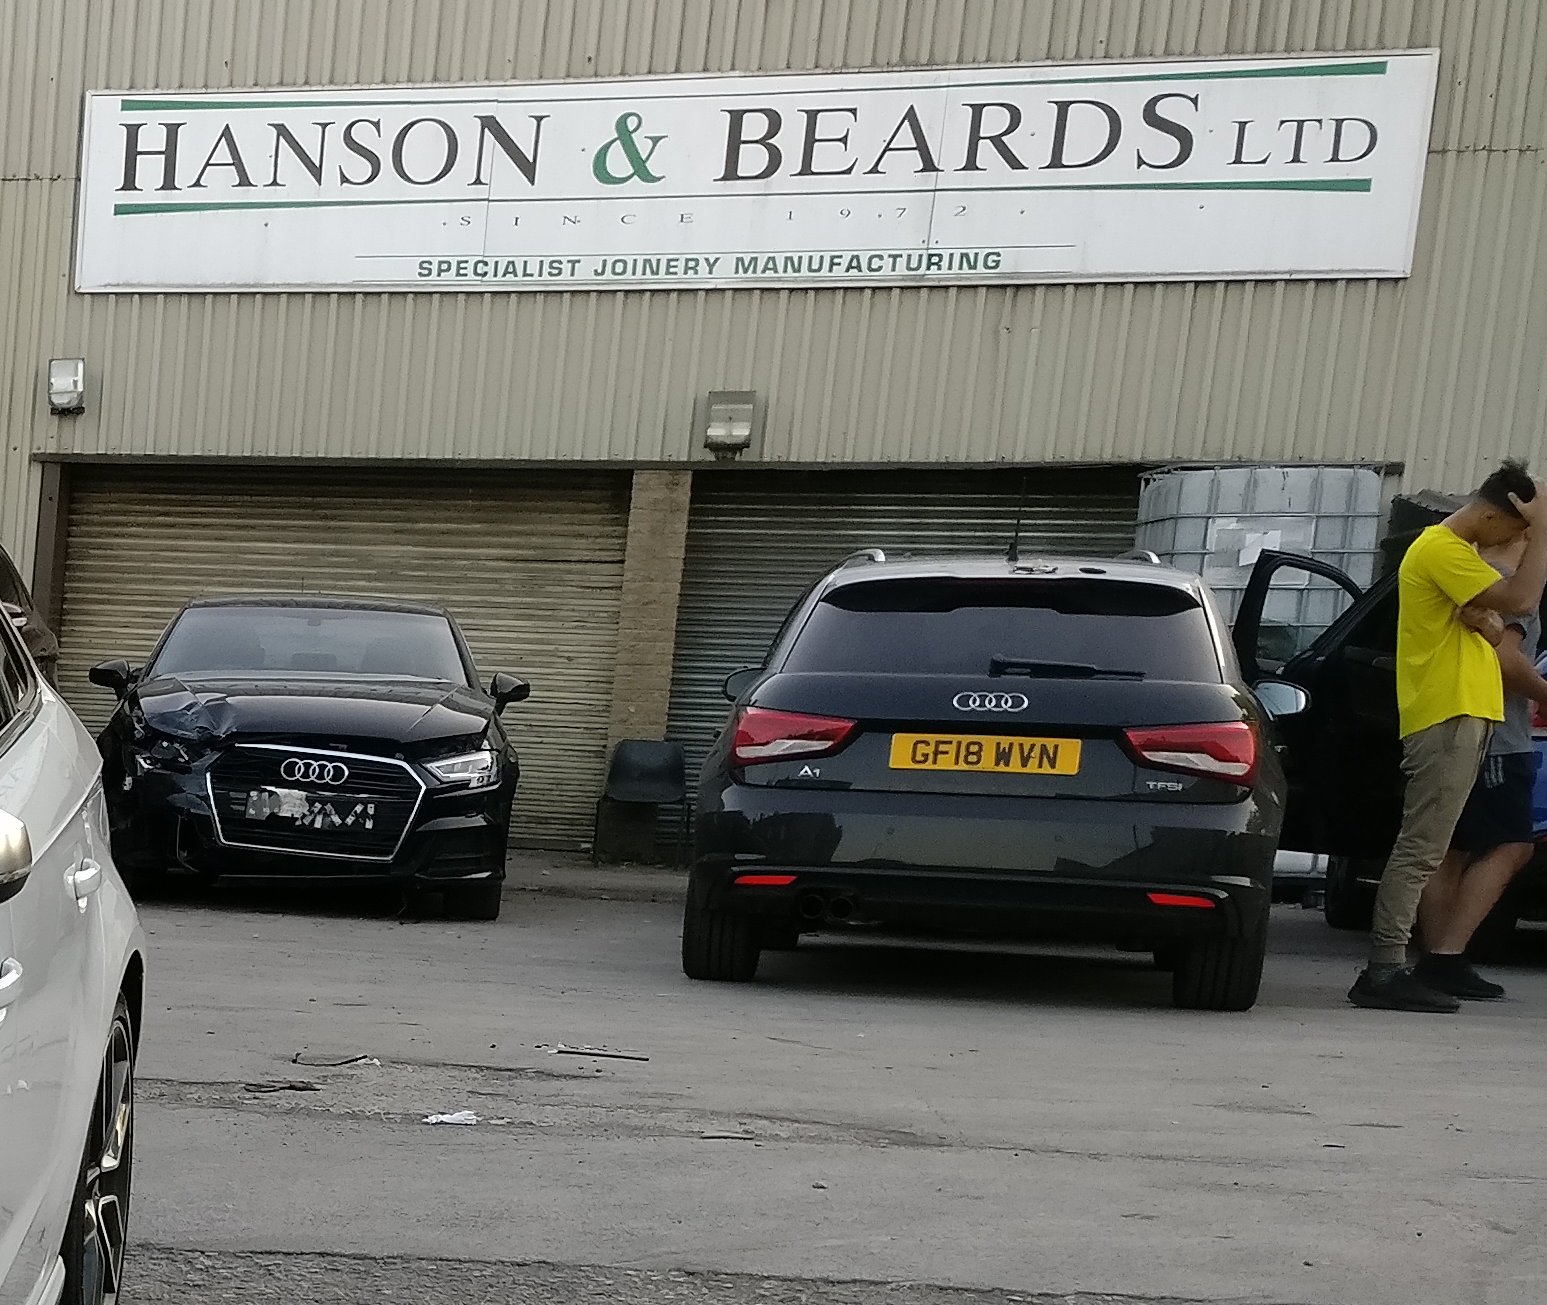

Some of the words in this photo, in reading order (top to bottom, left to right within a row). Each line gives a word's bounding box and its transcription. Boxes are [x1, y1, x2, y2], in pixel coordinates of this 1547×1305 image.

[113, 114, 551, 192] HANSON
[591, 110, 669, 186] &
[712, 92, 1200, 183] BEARDS
[1226, 117, 1379, 166] LTD
[459, 211, 694, 228] SINCE
[786, 204, 968, 222] 1972
[416, 259, 582, 279] SPECIALIST
[593, 256, 722, 278] JOINERY
[734, 250, 1003, 276] MANUFACTURING
[910, 739, 984, 767] GF18
[993, 741, 1060, 770] WVN
[797, 764, 821, 778] A1
[1145, 781, 1183, 791] TFSI
